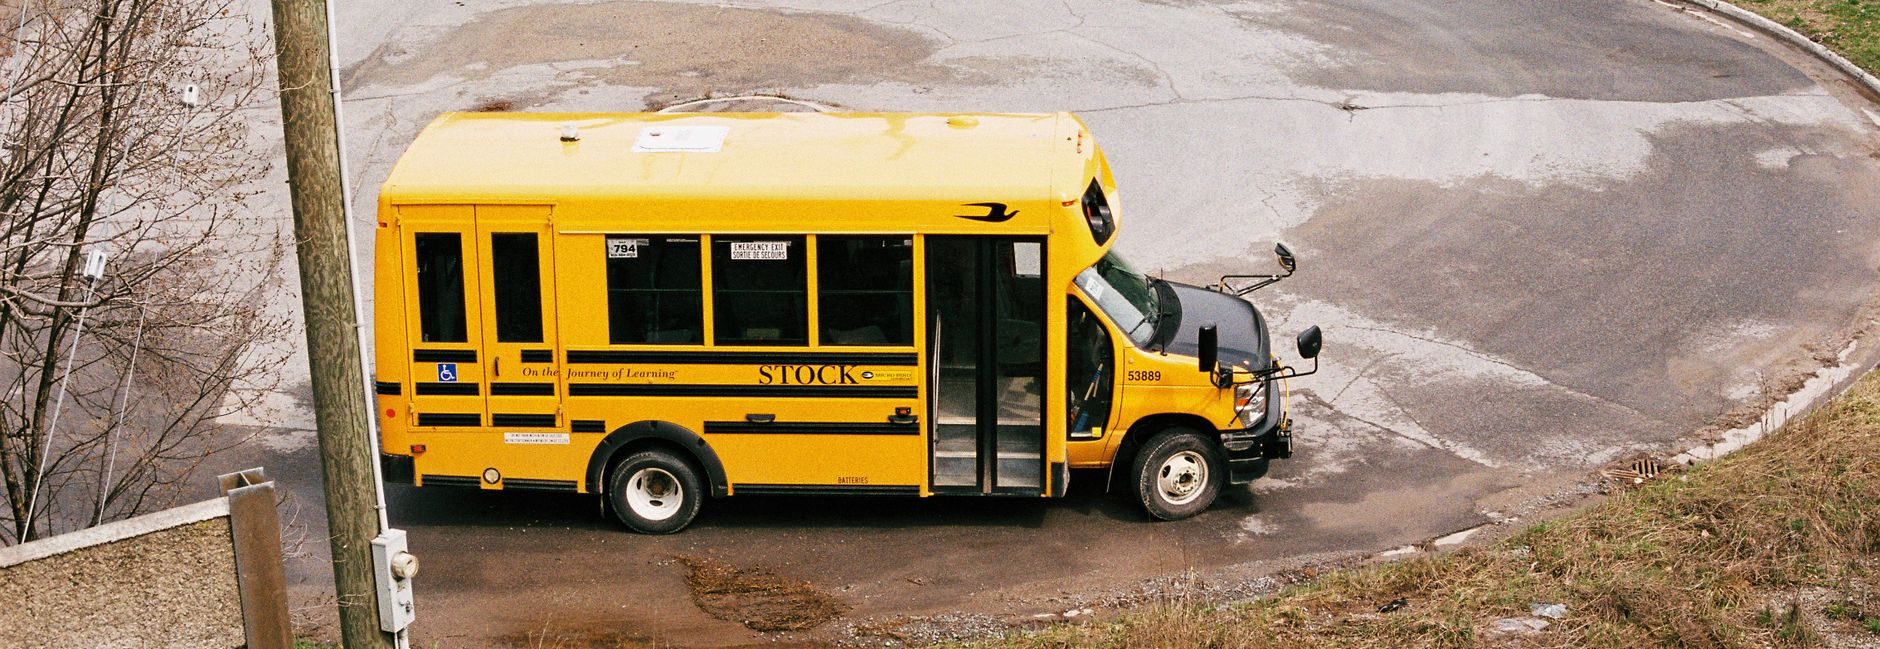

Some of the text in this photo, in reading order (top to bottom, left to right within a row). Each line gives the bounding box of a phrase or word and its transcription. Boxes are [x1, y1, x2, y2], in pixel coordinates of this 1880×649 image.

[614, 244, 636, 253] 794
[734, 243, 784, 251] EMERGENCY EXIT
[733, 251, 786, 259] SORTIE DE SECOURS
[522, 367, 675, 381] On the Journey of Learning
[758, 364, 860, 385] STOCK
[1127, 370, 1161, 381] 53889
[837, 476, 869, 484] BATTERIES
